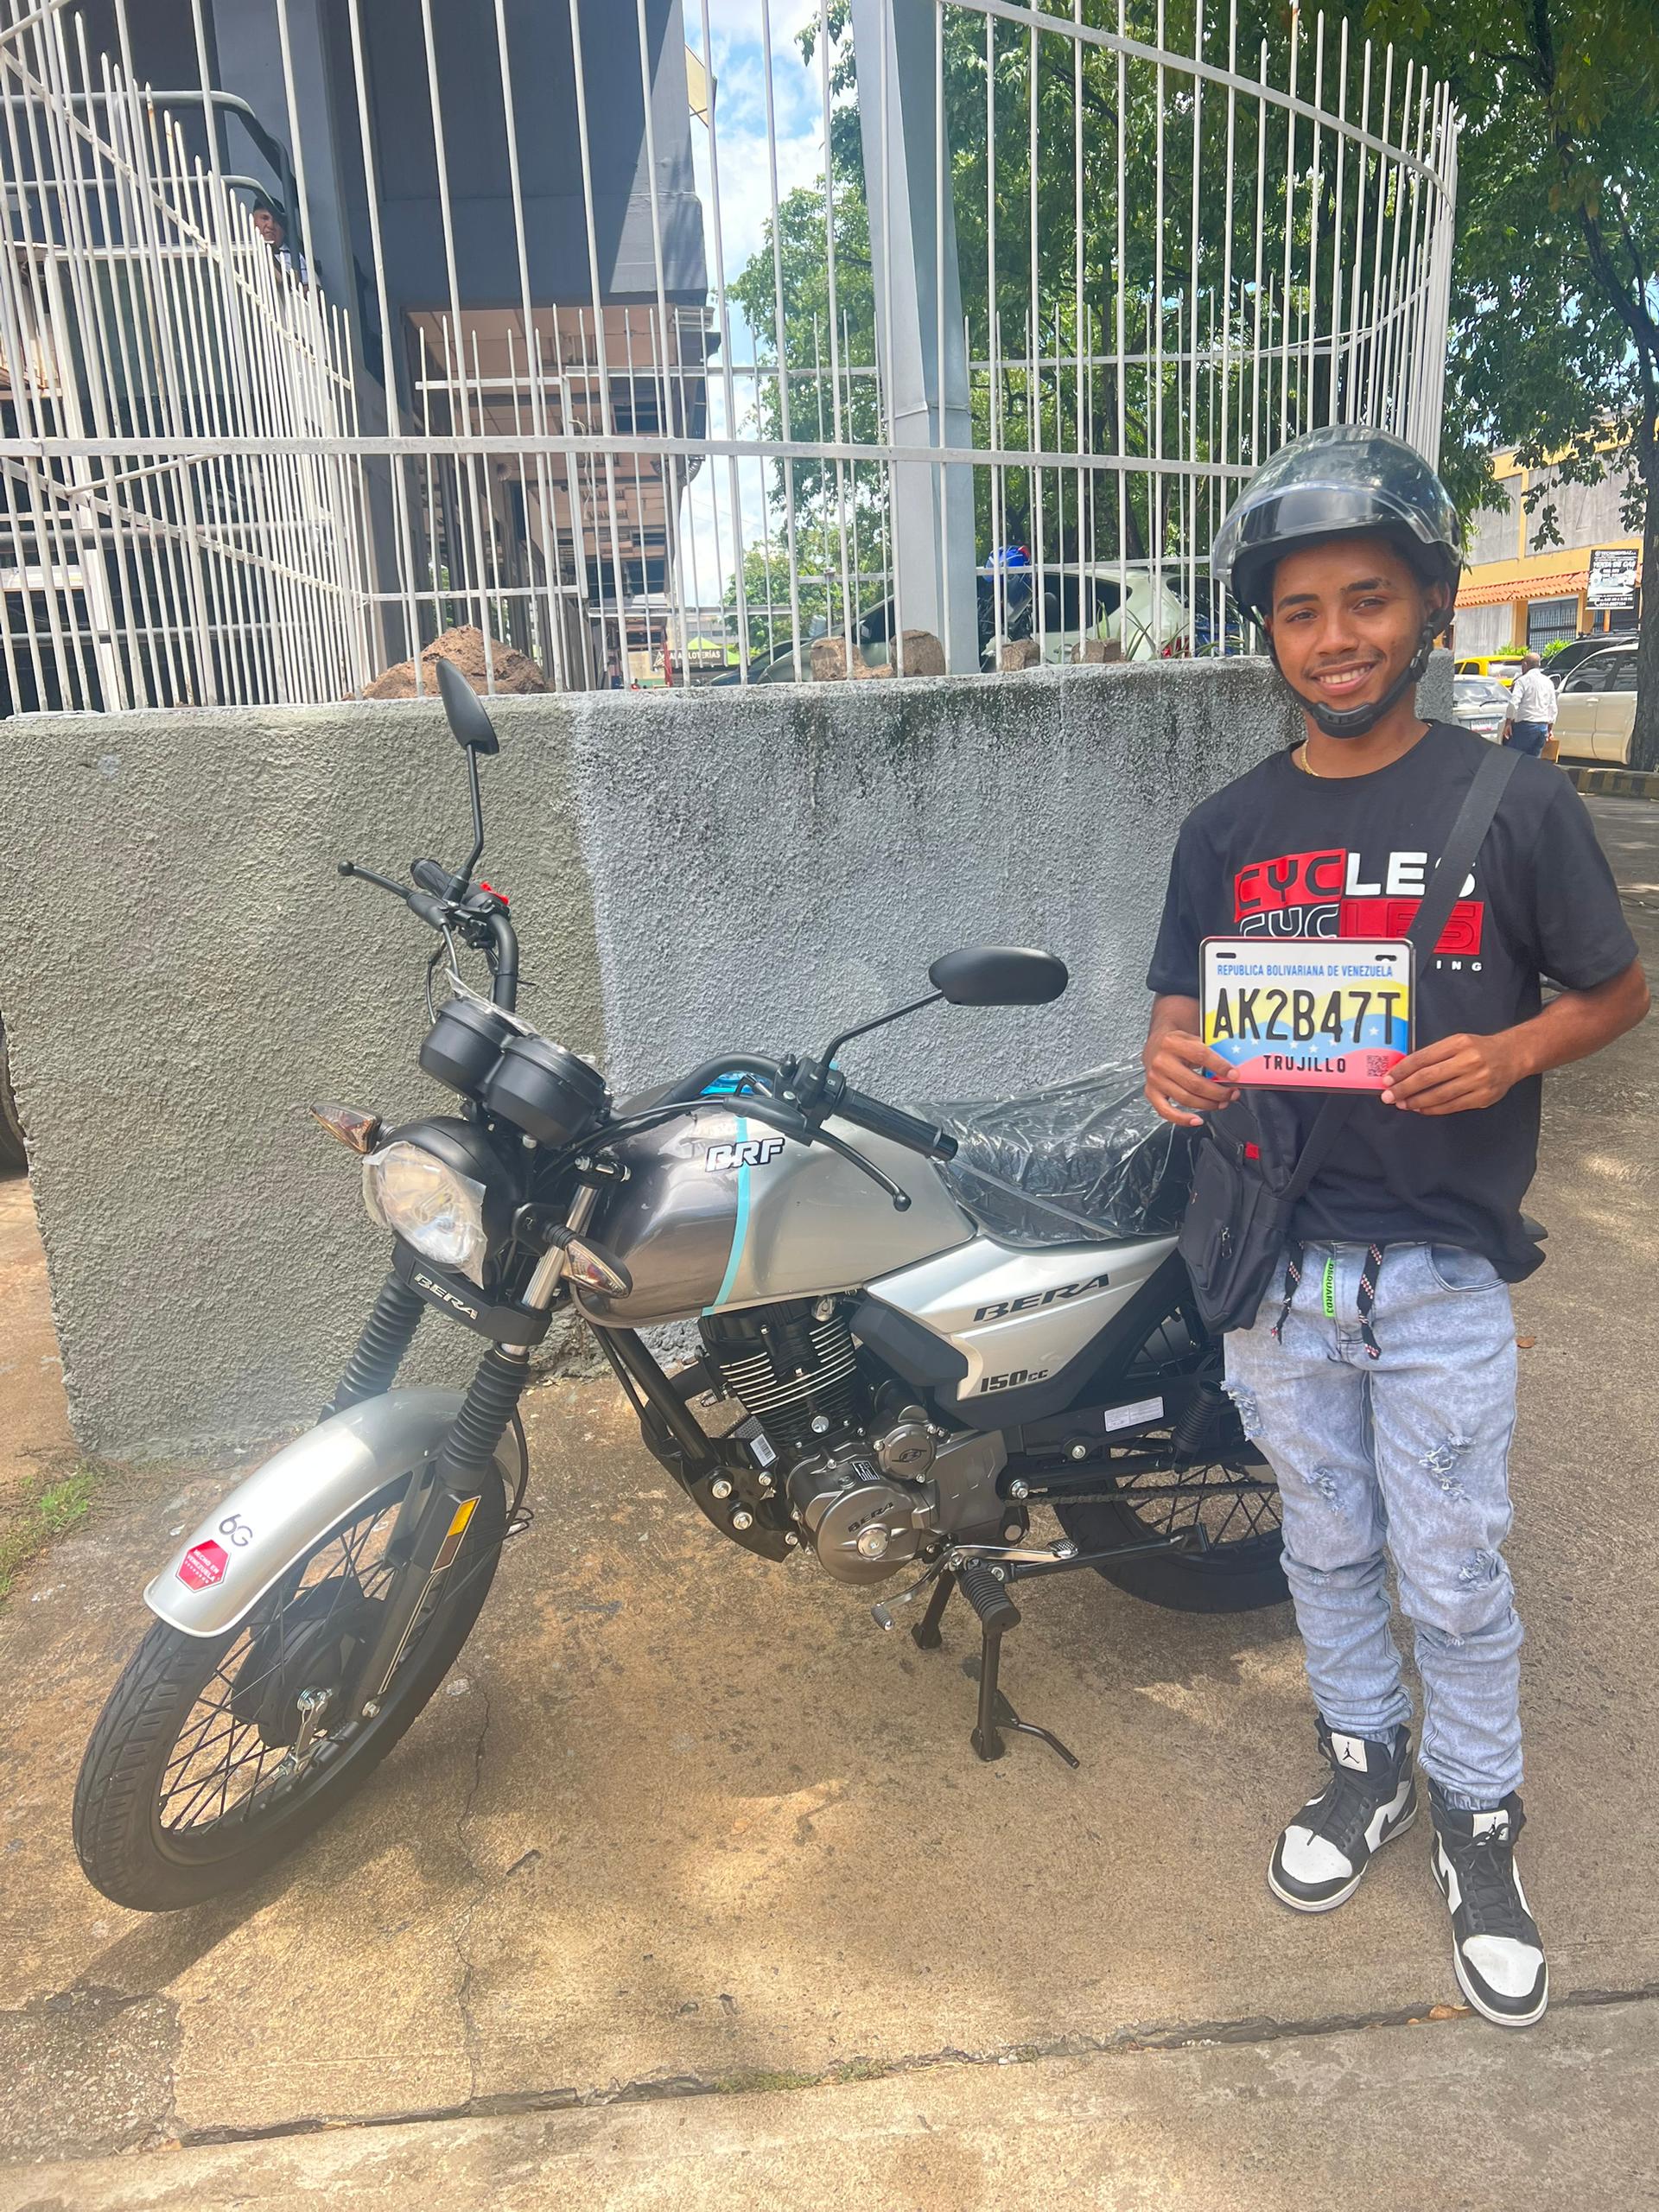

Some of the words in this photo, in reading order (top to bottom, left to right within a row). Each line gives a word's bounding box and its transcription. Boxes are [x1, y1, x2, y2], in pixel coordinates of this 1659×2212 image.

[1217, 964, 1263, 976] REPUBLICA
[1267, 964, 1325, 977] BOLIVARIANA
[1327, 965, 1338, 976] DE
[1342, 965, 1393, 977] VENEZUELA
[1213, 988, 1401, 1045] AK2B47T
[1263, 1054, 1345, 1073] TRUJILLO
[705, 1137, 785, 1173] BRF
[415, 1273, 478, 1320] BERA
[973, 1274, 1109, 1321] BERA
[848, 1502, 894, 1533] BERA
[188, 1554, 215, 1582] VENEZUELA
[194, 1549, 212, 1567] HECHO
[210, 1565, 219, 1574] EN
